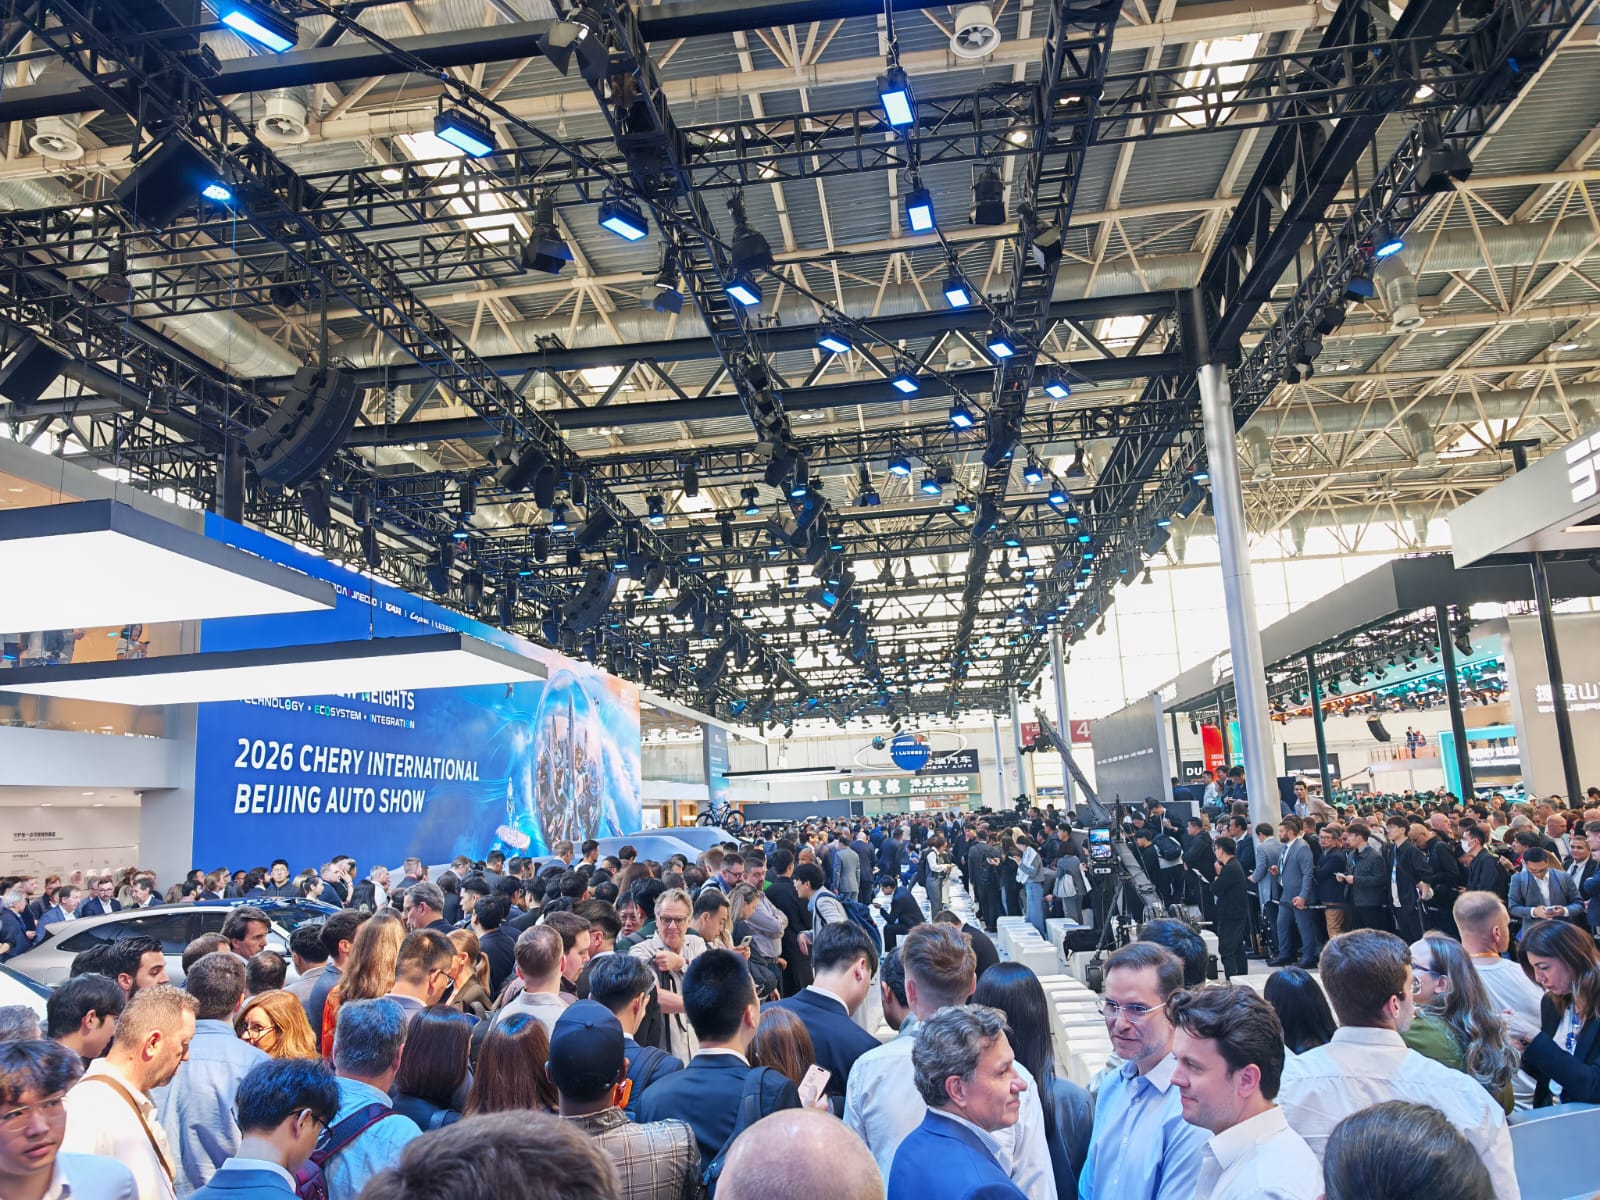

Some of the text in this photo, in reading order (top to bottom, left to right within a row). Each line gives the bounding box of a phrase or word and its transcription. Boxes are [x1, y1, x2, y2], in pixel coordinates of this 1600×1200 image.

[314, 705, 362, 721] ECOSYSTEM
[369, 713, 415, 729] INTEGRATION
[234, 738, 480, 782] 2026 CHERY INTERNATIONAL
[234, 783, 426, 814] BEIJING AUTO SHOW
